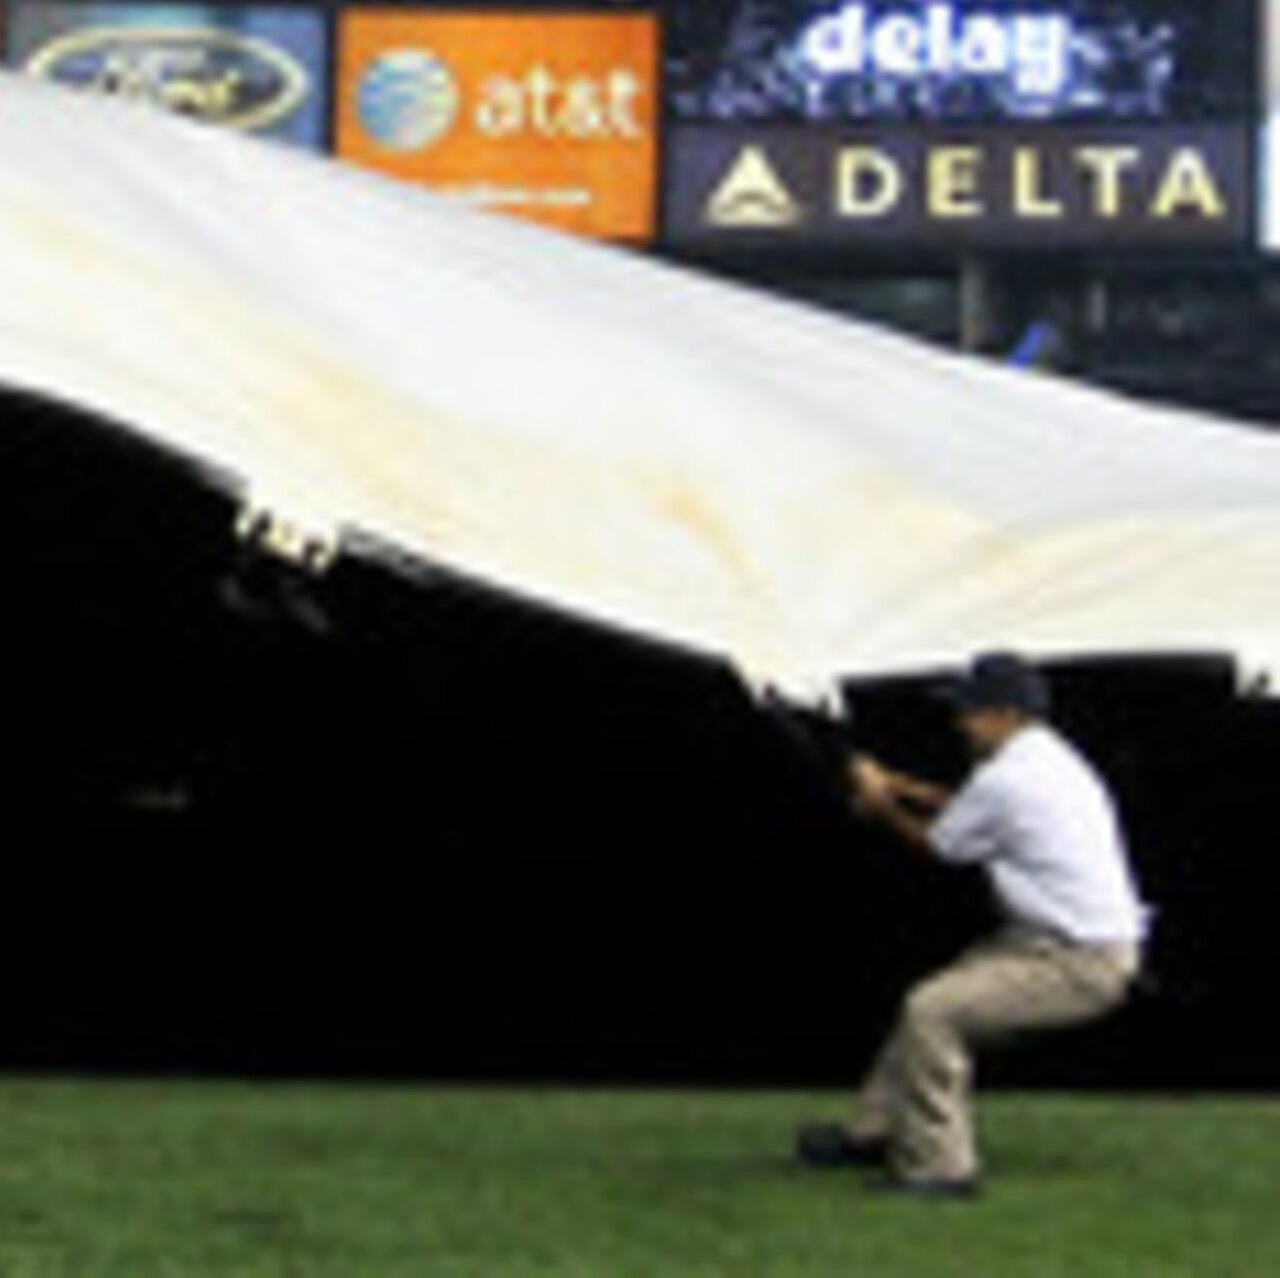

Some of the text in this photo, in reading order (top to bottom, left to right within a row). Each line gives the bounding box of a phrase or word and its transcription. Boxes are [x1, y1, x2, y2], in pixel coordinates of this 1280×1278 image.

[800, 4, 1072, 94] delay
[474, 62, 644, 139] at&t
[837, 146, 1226, 219] DELTA
